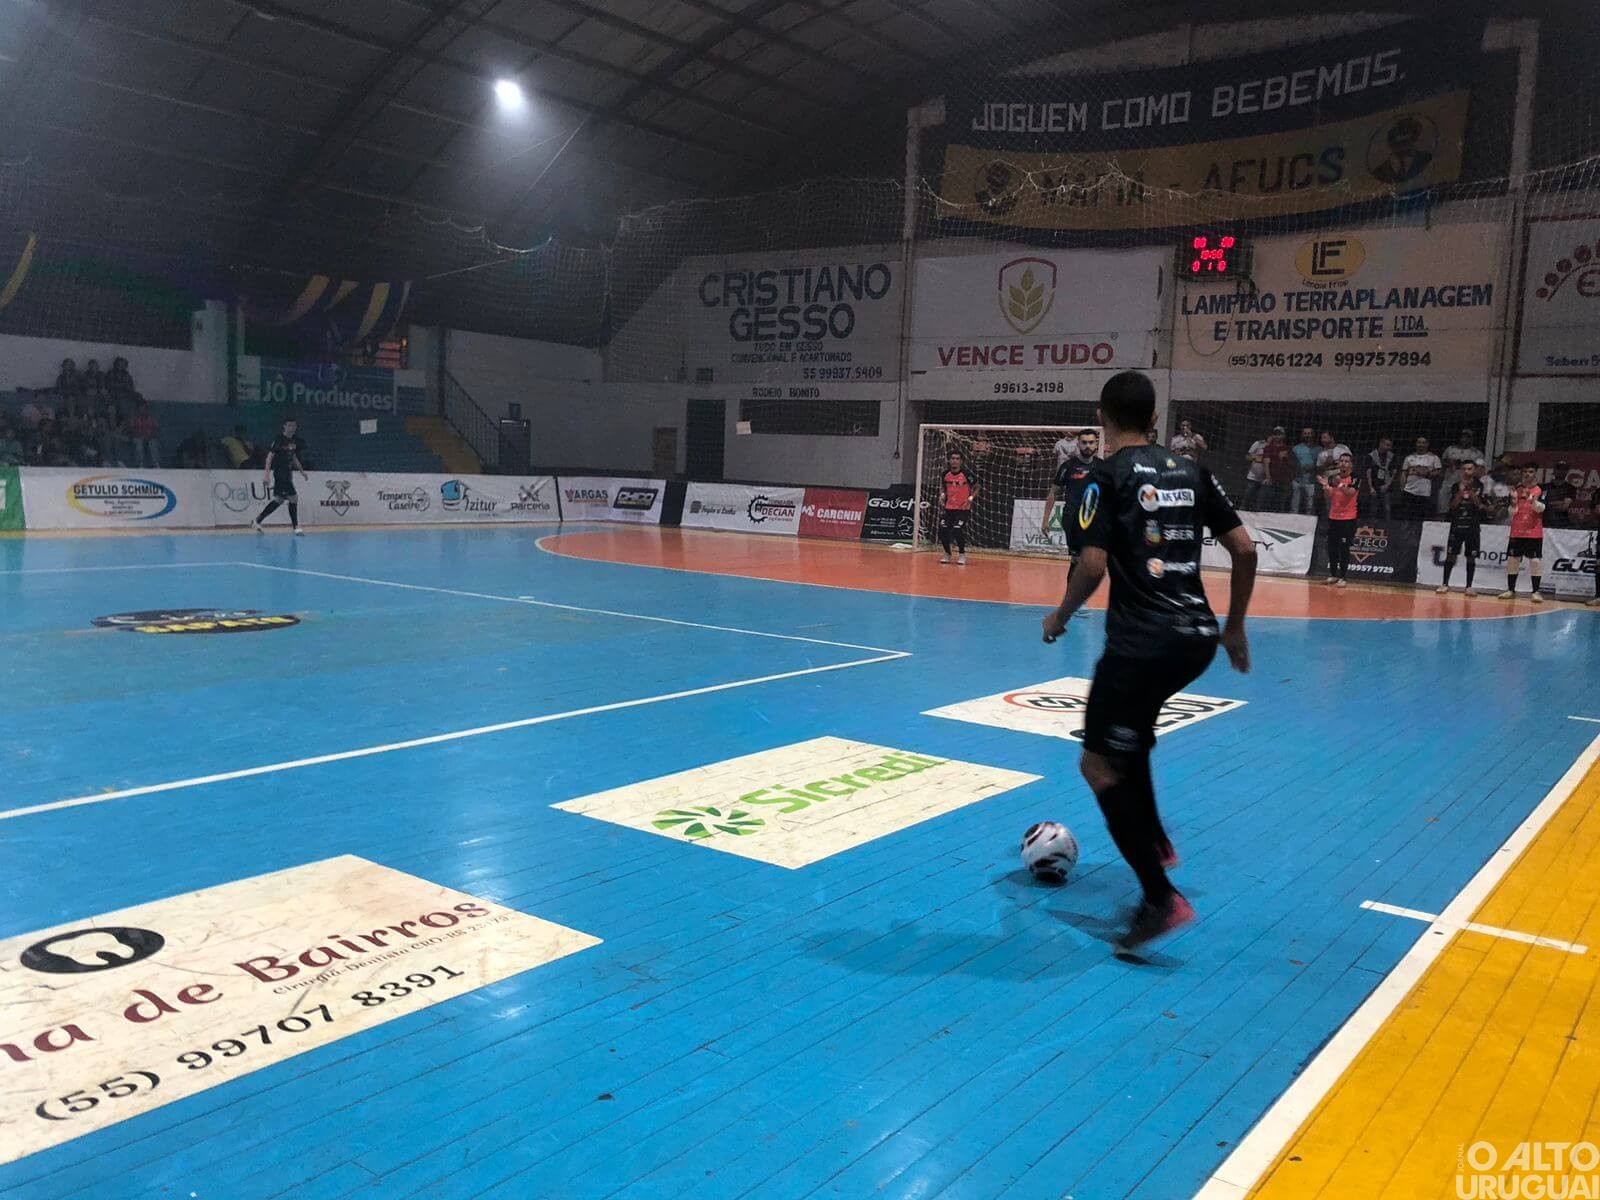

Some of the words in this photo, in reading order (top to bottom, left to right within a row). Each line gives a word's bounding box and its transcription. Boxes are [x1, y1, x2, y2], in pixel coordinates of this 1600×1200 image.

[972, 100, 1088, 132] JOGUEM
[1101, 91, 1191, 130] COMO
[699, 263, 891, 308] CRISTIANO
[1283, 284, 1493, 313] TERRAPLANAGEM
[730, 303, 855, 341] GESSO
[1214, 321, 1228, 345] E
[1234, 316, 1384, 342] TRANSPORTE
[937, 345, 1024, 366] VENCE
[1033, 342, 1114, 364] TUDO
[994, 382, 1064, 394] 99613-2198
[73, 484, 118, 495] GETULIO
[510, 502, 551, 511] Parceria
[817, 508, 862, 521] CARGNIN
[740, 752, 945, 814] Sicredi
[123, 983, 223, 1023] de
[233, 902, 491, 983] Bairros
[35, 1071, 160, 1120] (55)
[177, 1004, 334, 1069] 99707
[351, 965, 465, 1007] 8391
